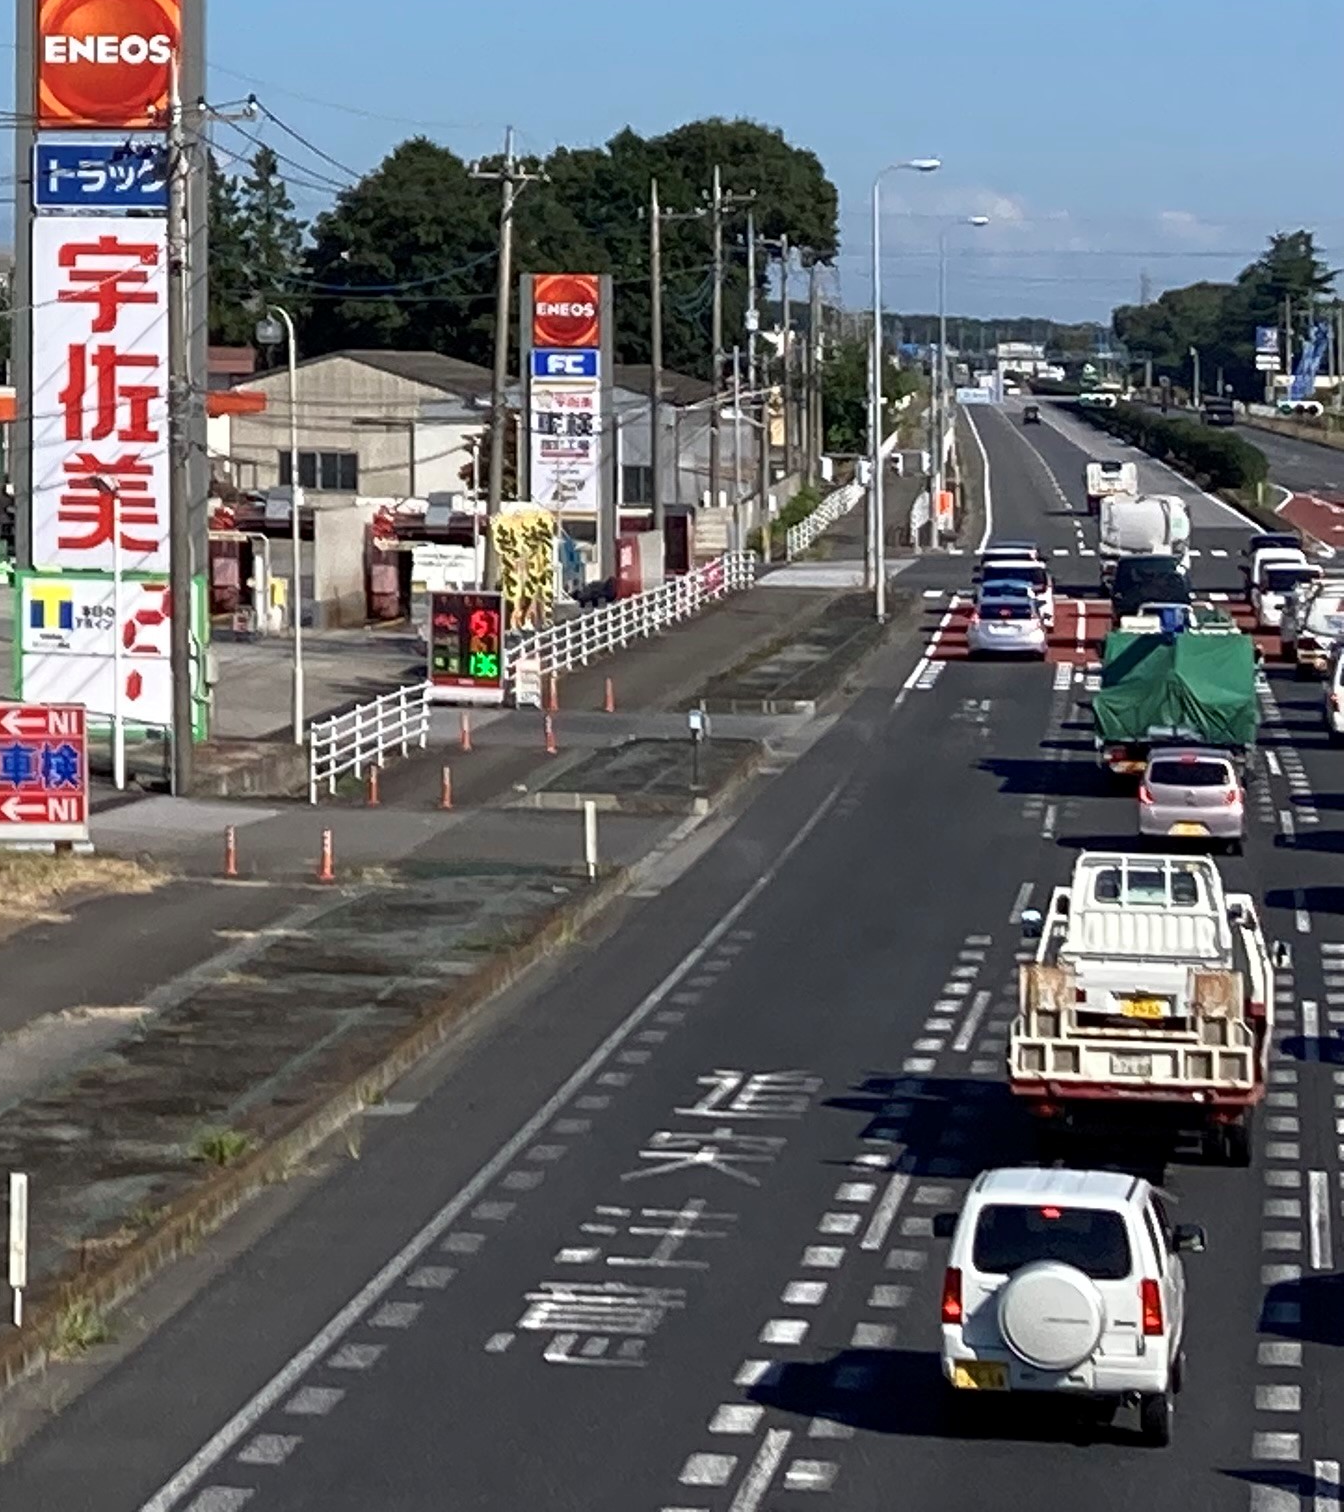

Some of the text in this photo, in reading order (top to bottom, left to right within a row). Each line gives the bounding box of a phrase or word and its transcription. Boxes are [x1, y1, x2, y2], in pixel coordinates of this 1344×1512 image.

[44, 35, 172, 64] ENEOS
[536, 302, 595, 317] ENEOS
[57, 235, 159, 553] 宇佐美
